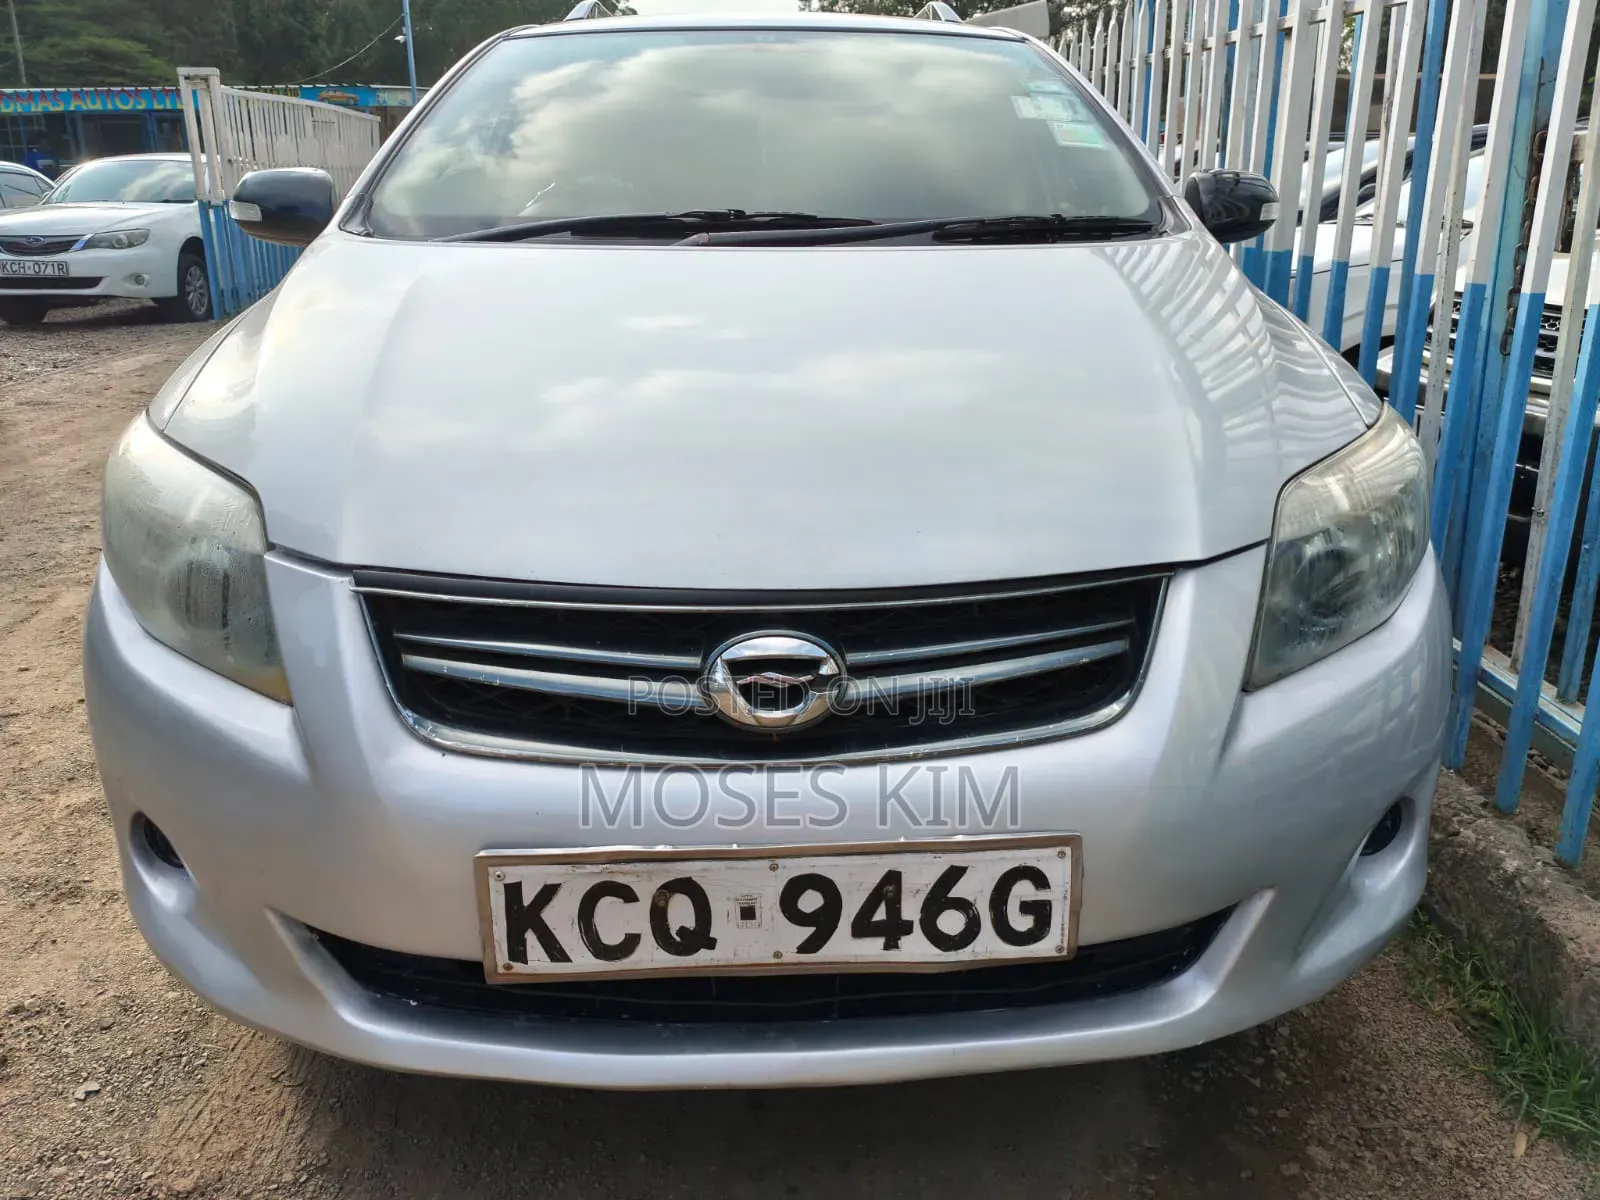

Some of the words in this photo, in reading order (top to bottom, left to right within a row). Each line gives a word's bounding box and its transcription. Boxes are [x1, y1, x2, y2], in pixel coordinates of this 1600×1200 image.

[69, 88, 147, 111] AUTOS
[1, 261, 26, 274] KCH
[33, 262, 66, 275] 071R
[504, 876, 717, 965] KCQ
[779, 865, 1053, 954] 946G
